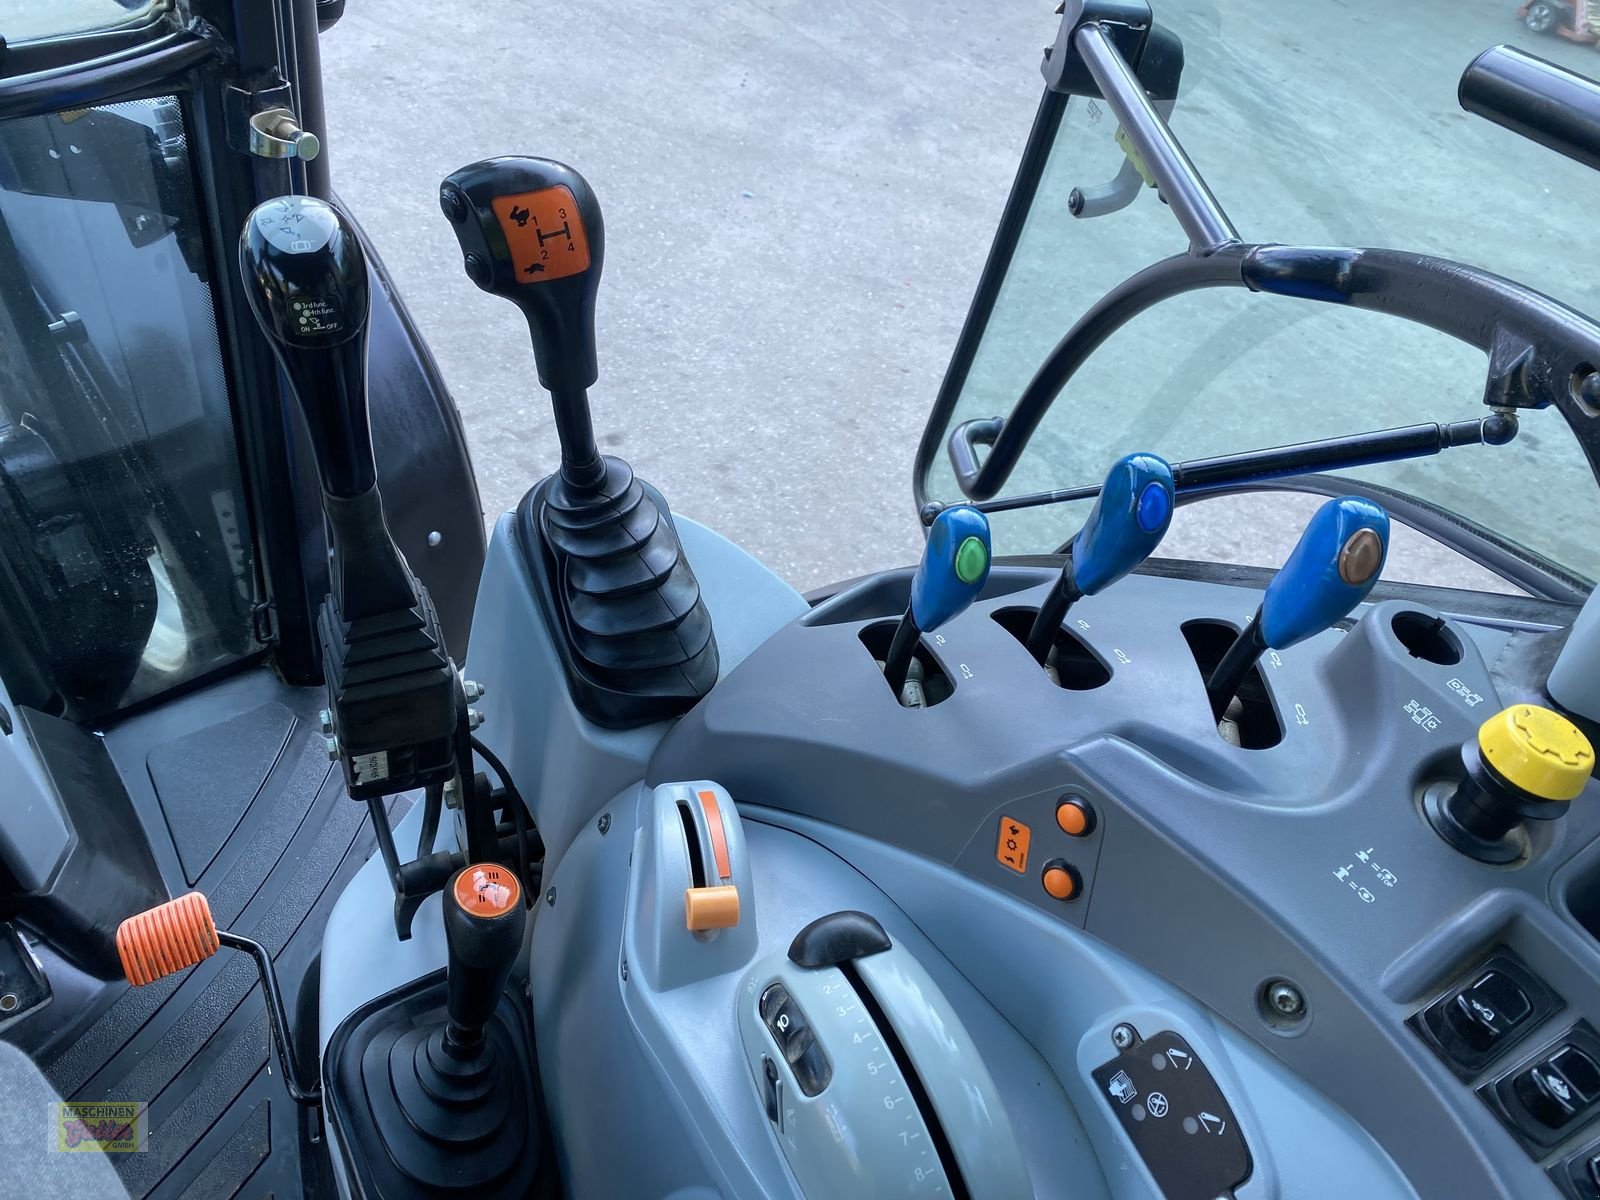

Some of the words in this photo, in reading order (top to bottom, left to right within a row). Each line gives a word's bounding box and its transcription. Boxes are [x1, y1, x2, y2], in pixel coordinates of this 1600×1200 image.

[558, 208, 567, 219] 3
[532, 216, 538, 226] 1
[567, 242, 575, 253] 4
[540, 250, 549, 260] 2
[1376, 872, 1394, 888] STOP
[823, 985, 834, 995] 2
[836, 1006, 847, 1017] 3
[776, 1014, 789, 1033] 10
[852, 1032, 863, 1045] 4
[866, 1061, 878, 1076] 5
[883, 1096, 895, 1110] 6
[898, 1131, 909, 1146] 7
[914, 1167, 925, 1182] 8
